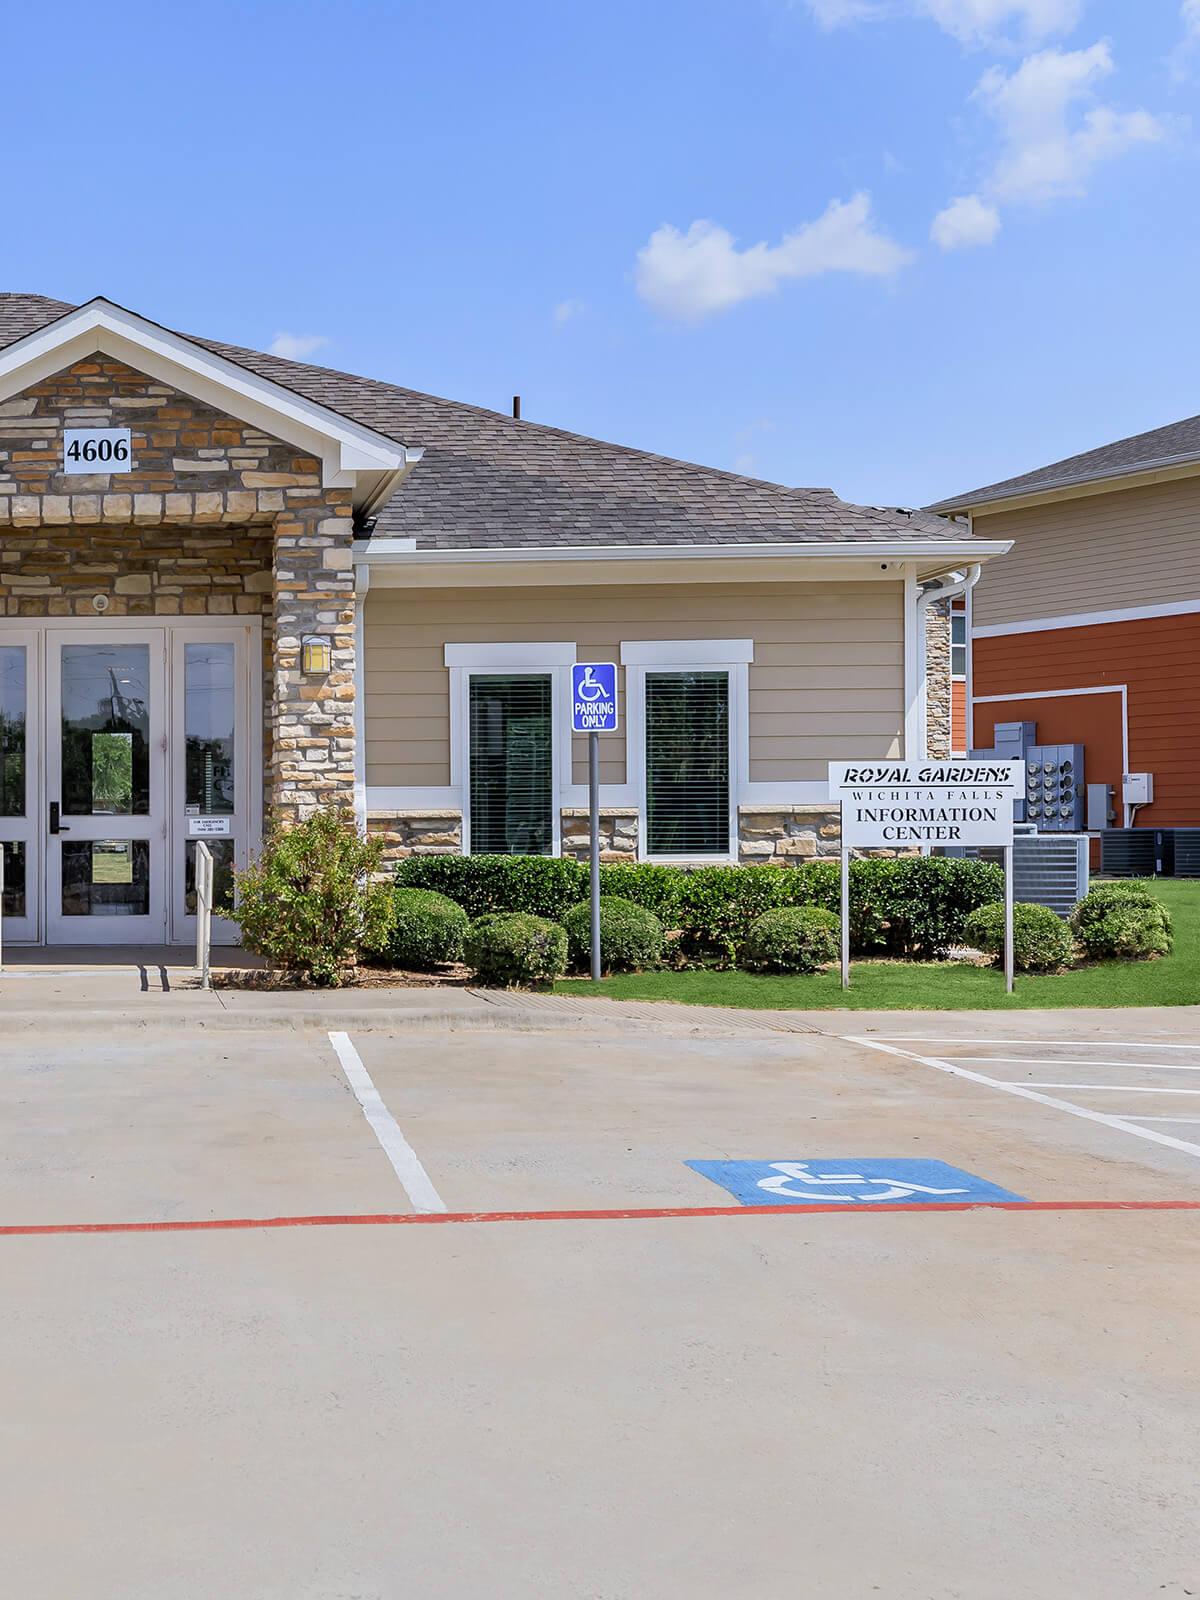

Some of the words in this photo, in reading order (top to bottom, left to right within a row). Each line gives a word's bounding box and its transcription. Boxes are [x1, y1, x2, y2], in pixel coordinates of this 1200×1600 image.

[67, 439, 128, 461] 4606
[575, 702, 614, 715] PARKING
[582, 715, 607, 728] ONLY
[844, 768, 911, 783] ROYAL
[918, 767, 1011, 783] GARDENS
[852, 792, 935, 801] WICHITA
[947, 791, 1004, 800] FALLS
[856, 808, 997, 822] INFORMATION
[883, 826, 961, 840] CENTER
